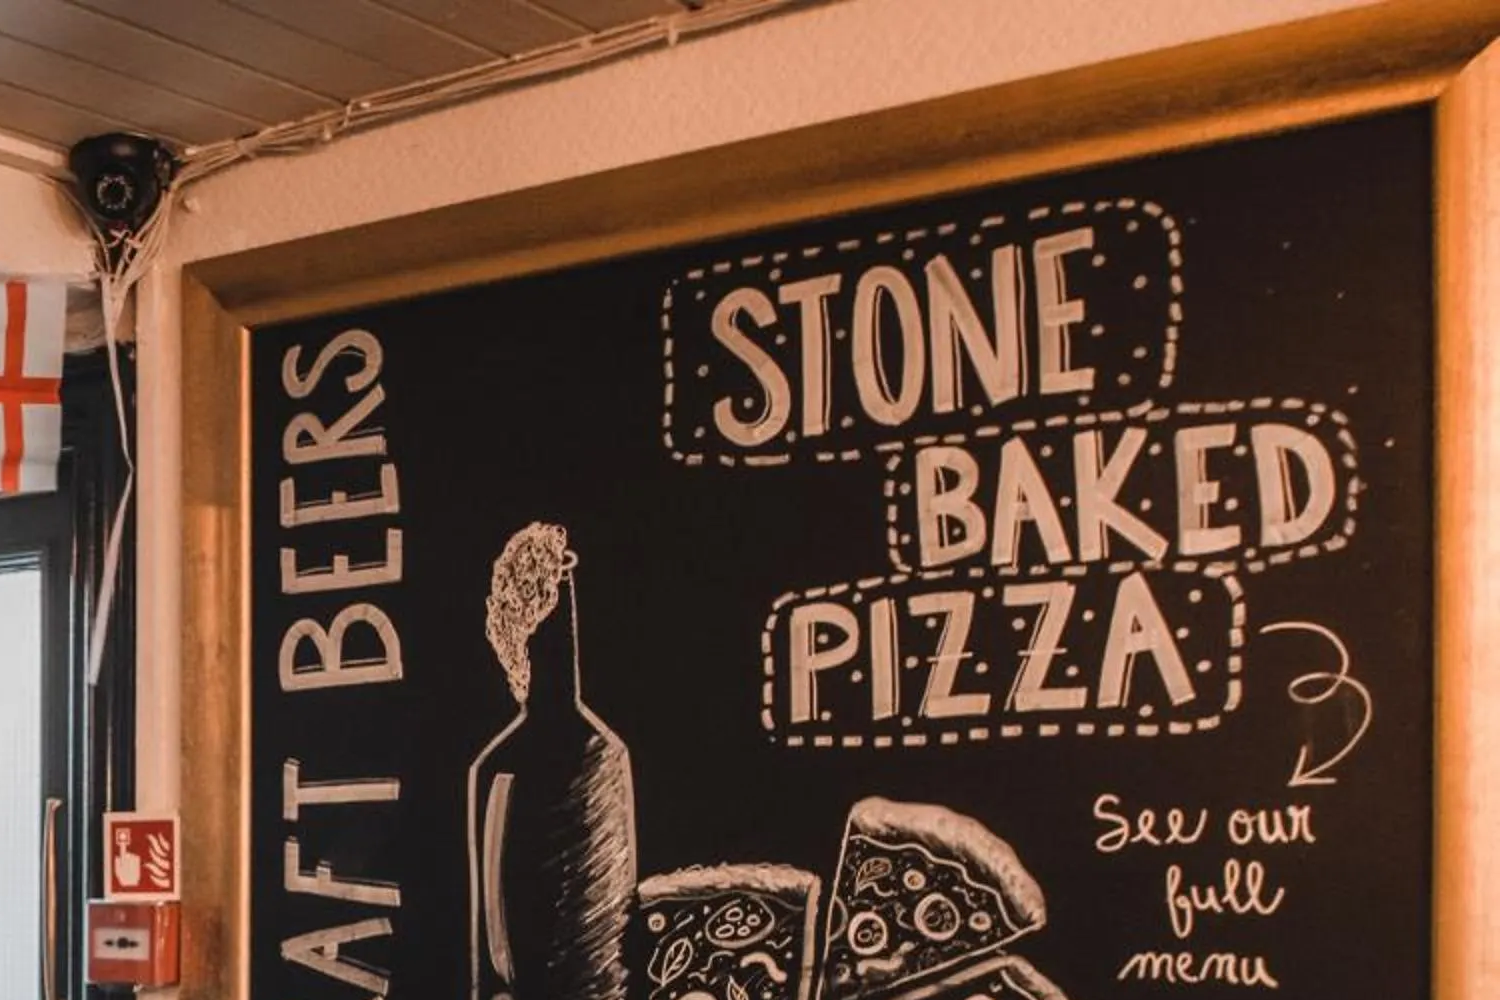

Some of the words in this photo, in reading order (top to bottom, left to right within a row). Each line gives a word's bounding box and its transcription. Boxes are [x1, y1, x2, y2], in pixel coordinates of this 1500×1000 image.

[710, 227, 1096, 447] STONE
[278, 328, 403, 692] BEERS
[915, 423, 1336, 567] BAKED
[790, 571, 1196, 723] PIZZA
[1093, 793, 1208, 852] See
[1228, 804, 1316, 845] our
[1117, 951, 1279, 988] menu
[1166, 858, 1285, 939] full
